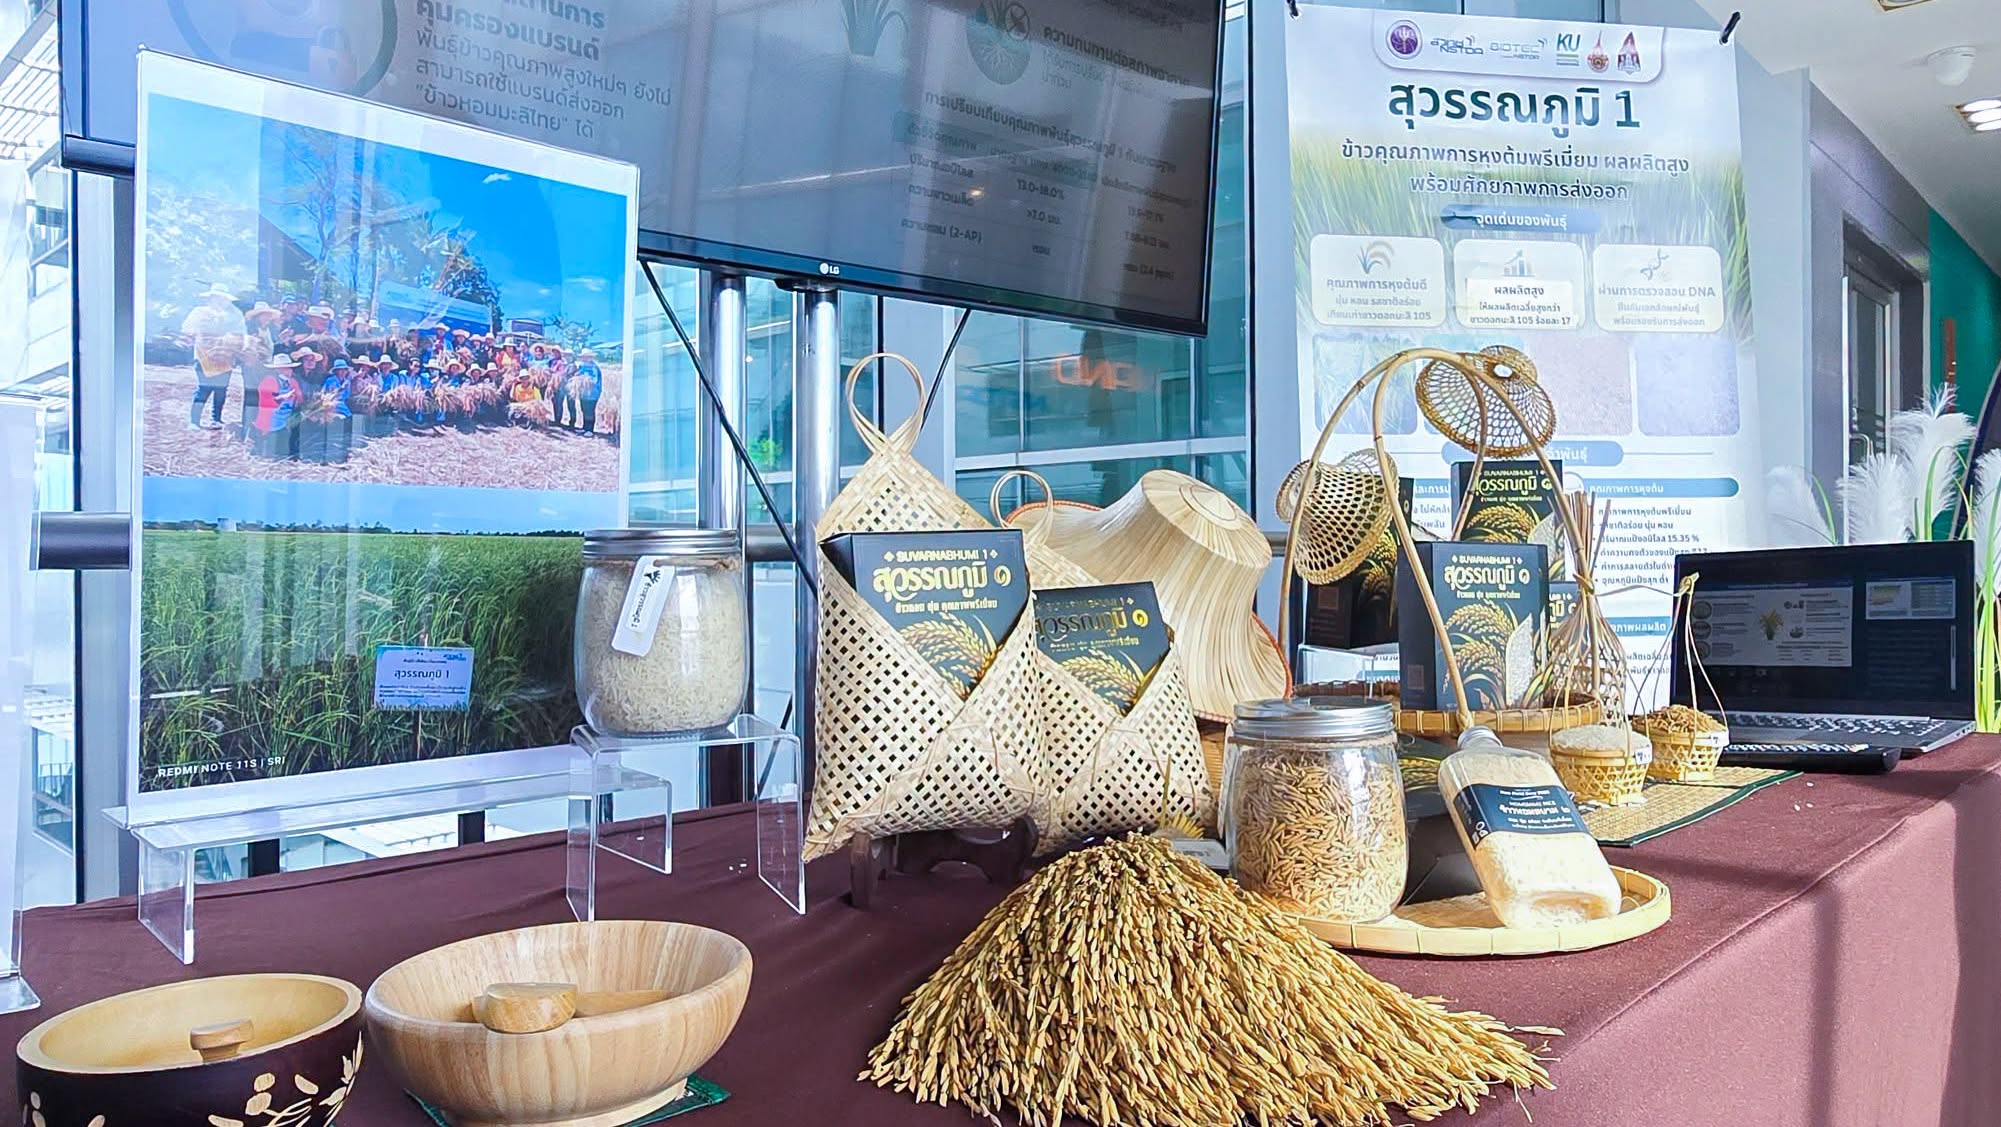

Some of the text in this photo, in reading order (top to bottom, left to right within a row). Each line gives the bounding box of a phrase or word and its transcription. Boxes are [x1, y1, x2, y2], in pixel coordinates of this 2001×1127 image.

[1556, 33, 1580, 52] KU
[633, 85, 672, 106] ยังไม่
[1389, 83, 1640, 138] สุวรรณภูมิ 1
[576, 118, 594, 138] ได้
[1342, 139, 1690, 177] ข้าวคุณภาพการหุงต้มพรีเมี่ยม ผลผลิตสูง
[1411, 173, 1629, 201] พร้อมศักยภาพการส่งออก
[1476, 211, 1568, 231] จุดเด่นของพันธุ์
[829, 266, 840, 275] LG
[1494, 285, 1544, 298] ผลผลิตสูง
[1688, 286, 1716, 297] DNA
[1413, 311, 1432, 320] 105
[1517, 316, 1534, 325] 105
[1562, 316, 1571, 325] 17
[1667, 534, 1690, 543] 15.35
[896, 549, 979, 563] SUVARNABHUMI
[872, 561, 988, 603] สุวรรณภูมิ
[1444, 564, 1515, 591] สุวรรณภูมิ
[394, 668, 442, 681] สุวรรณภูมิ
[158, 756, 285, 778] REDMI NOTE 11S SRI
